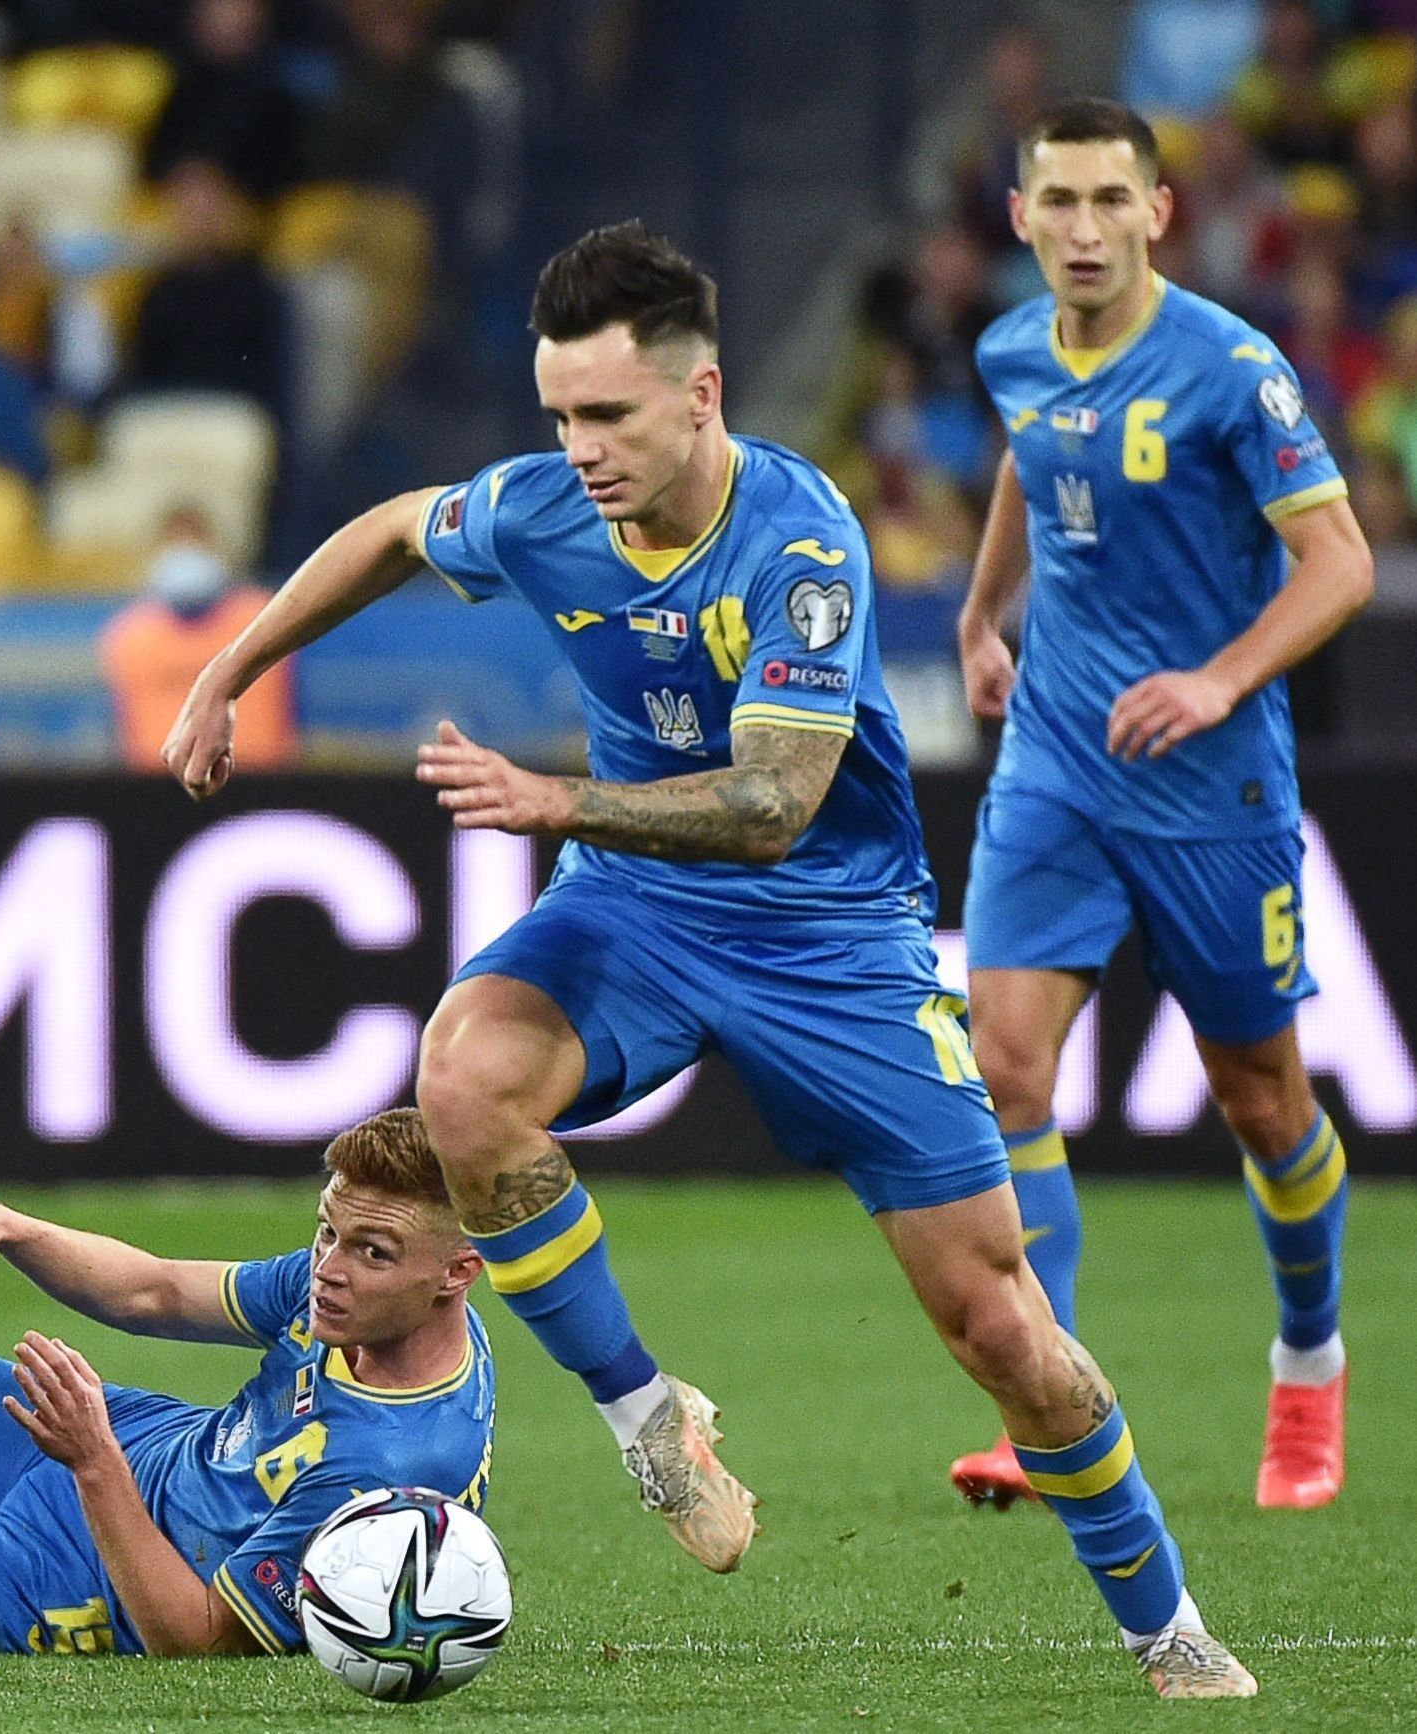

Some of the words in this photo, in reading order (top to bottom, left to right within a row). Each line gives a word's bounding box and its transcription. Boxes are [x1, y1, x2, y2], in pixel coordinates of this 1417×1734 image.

[1123, 398, 1169, 483] 6
[789, 667, 848, 688] RESPECT
[1262, 882, 1295, 967] 6
